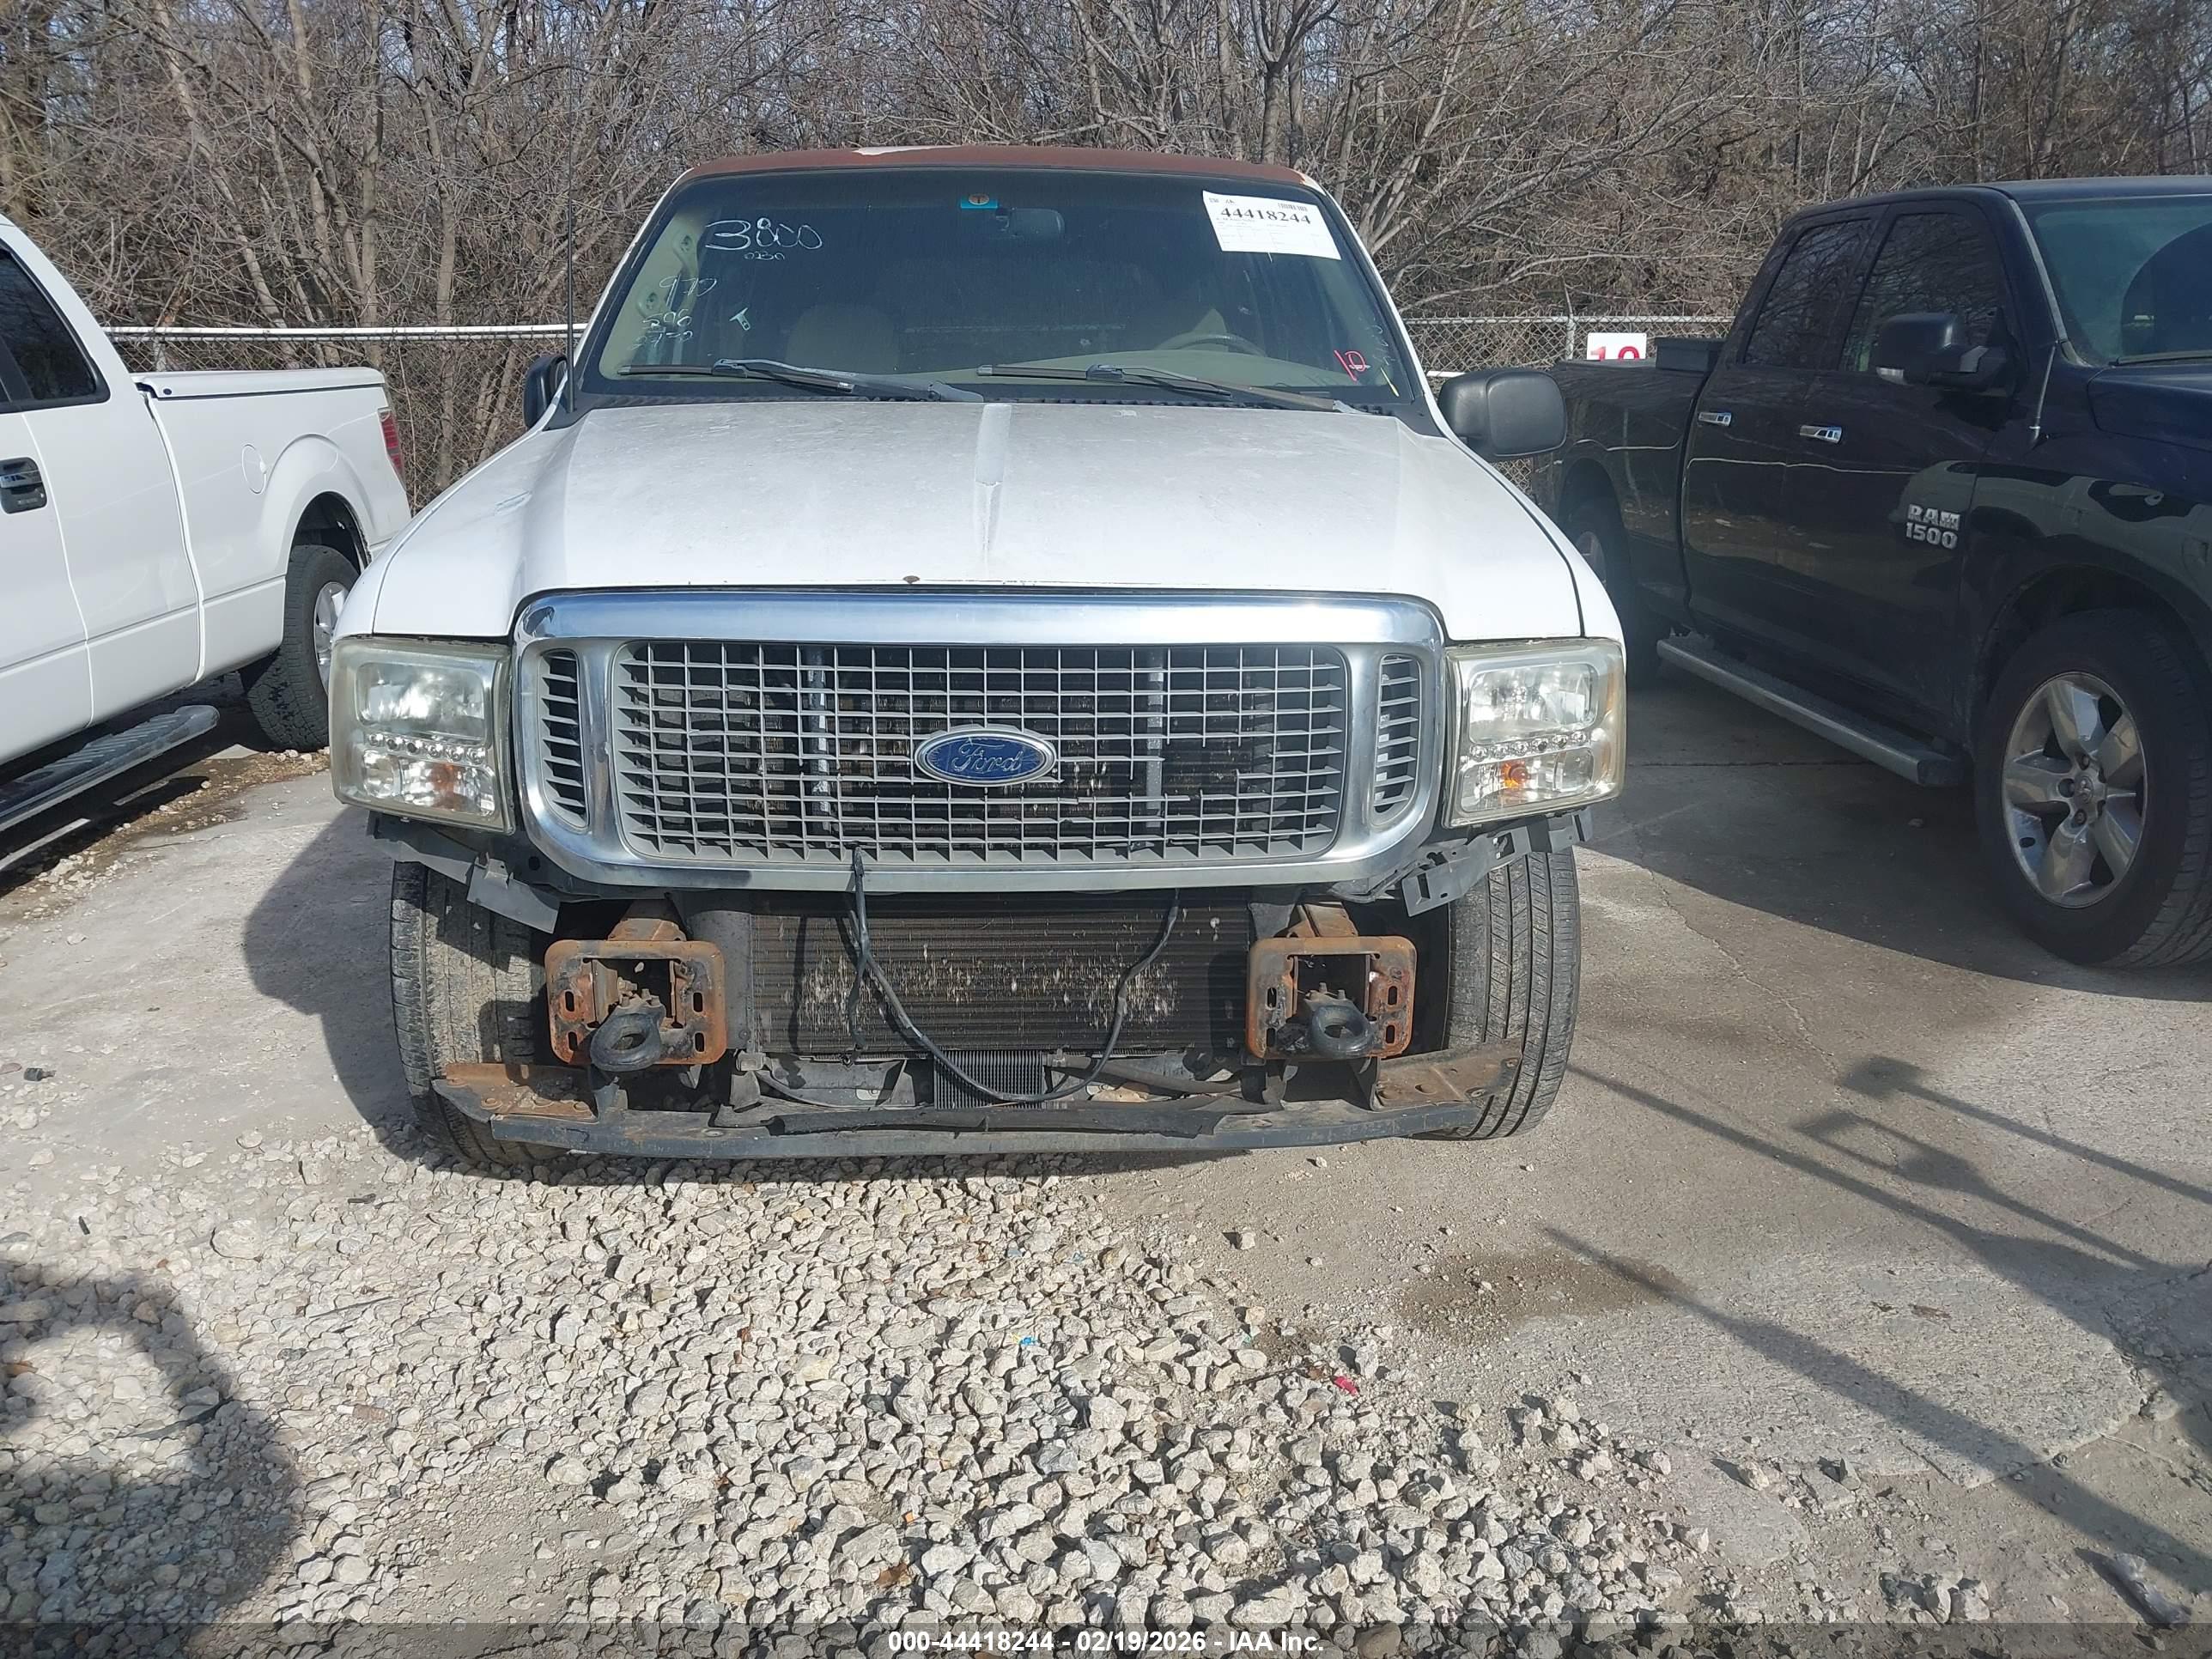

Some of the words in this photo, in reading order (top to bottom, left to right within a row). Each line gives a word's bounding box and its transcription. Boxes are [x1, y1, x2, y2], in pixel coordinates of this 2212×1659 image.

[1220, 207, 1311, 225] 44418244
[704, 217, 823, 250] 3800
[1908, 503, 1960, 531] RAM
[1906, 522, 1958, 550] 1500
[951, 739, 1024, 772] Ford
